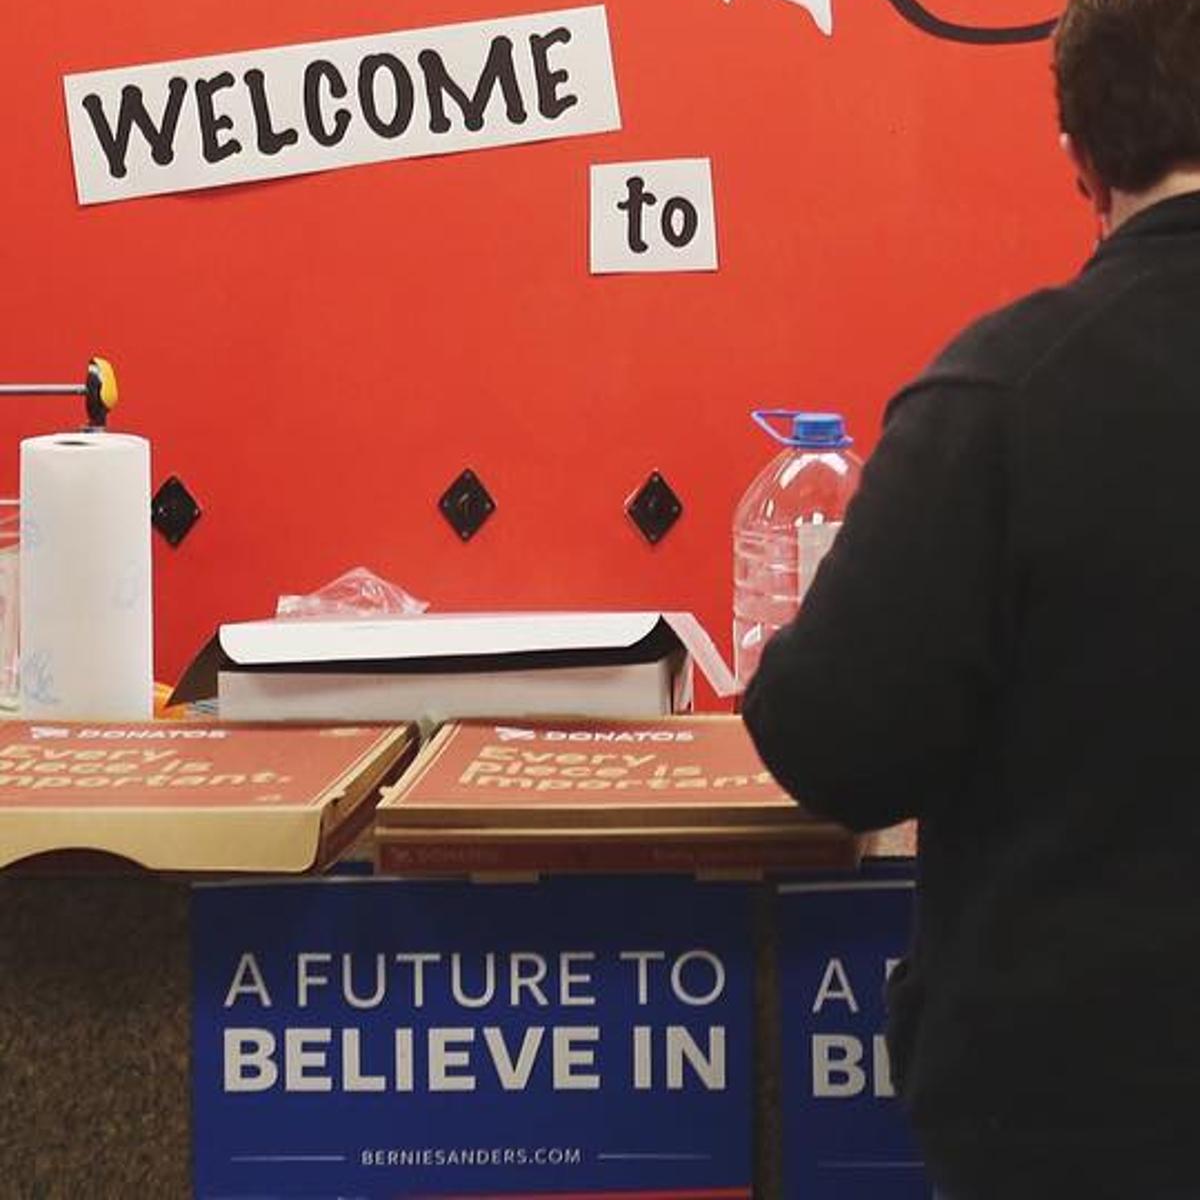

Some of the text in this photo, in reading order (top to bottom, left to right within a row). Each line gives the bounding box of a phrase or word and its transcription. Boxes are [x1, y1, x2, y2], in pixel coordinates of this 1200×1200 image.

[83, 27, 578, 178] WELCOME
[617, 176, 698, 254] to
[0, 744, 178, 763] Every
[76, 729, 228, 740] DONATOS
[543, 730, 695, 742] DONATOS
[479, 745, 657, 768] Every
[224, 951, 726, 1009] A FUTURE TO
[812, 958, 860, 1014] A
[223, 1025, 726, 1092] BELIEVE IN
[361, 1147, 582, 1166] BERNIESANDERS.COM
